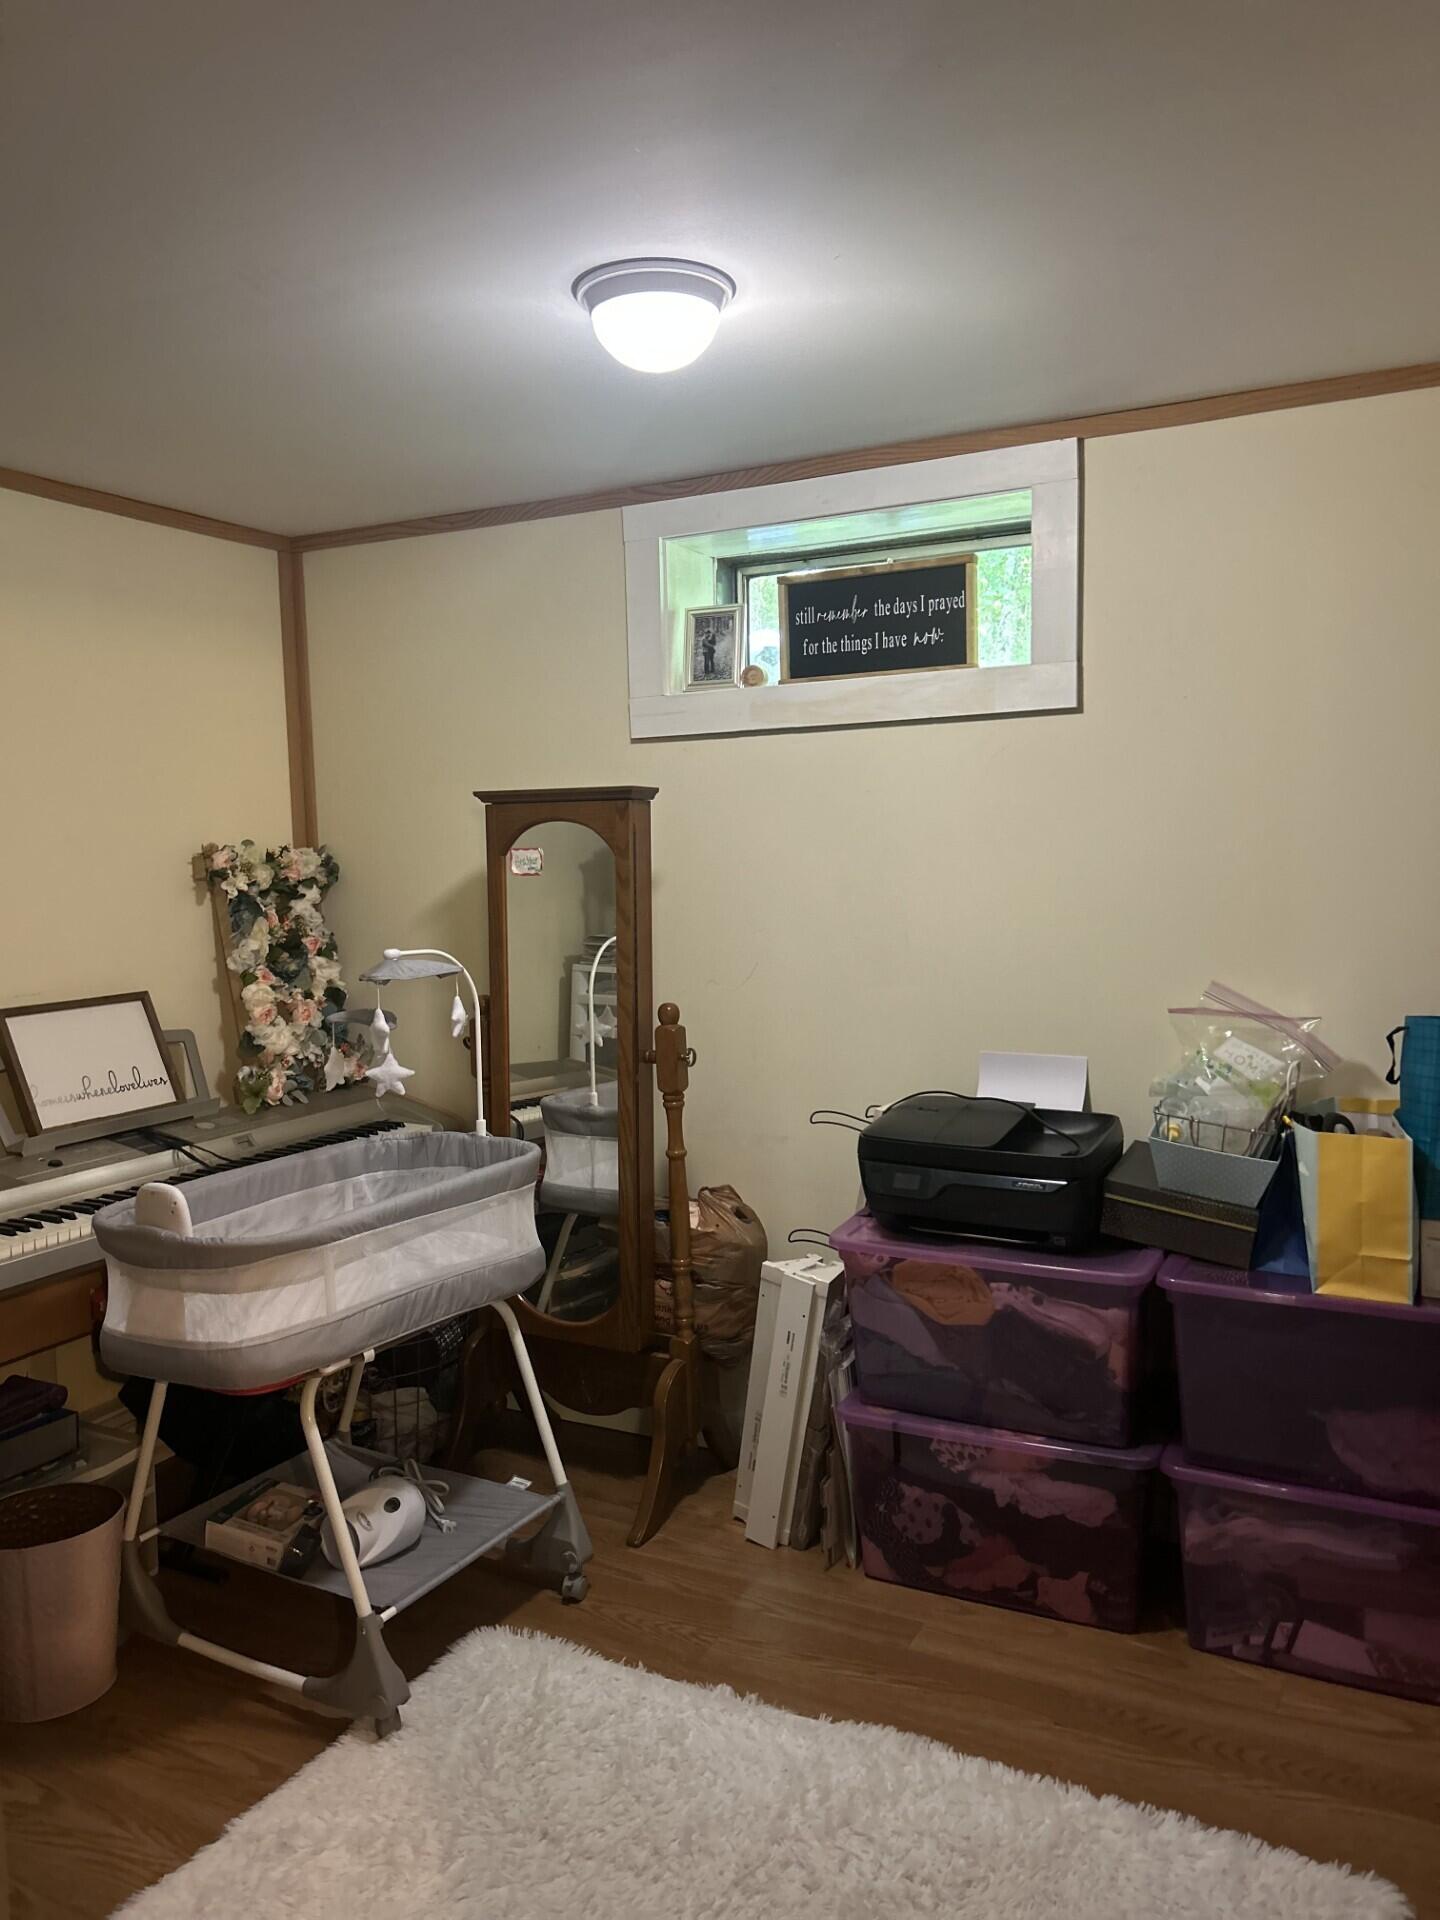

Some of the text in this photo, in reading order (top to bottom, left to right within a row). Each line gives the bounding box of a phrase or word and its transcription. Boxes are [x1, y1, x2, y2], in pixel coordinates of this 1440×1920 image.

[795, 589, 965, 626] still remember the days I prayed
[803, 638, 819, 656] for
[822, 636, 838, 654] the
[841, 633, 873, 656] things
[875, 631, 879, 649] I
[882, 631, 907, 649] have
